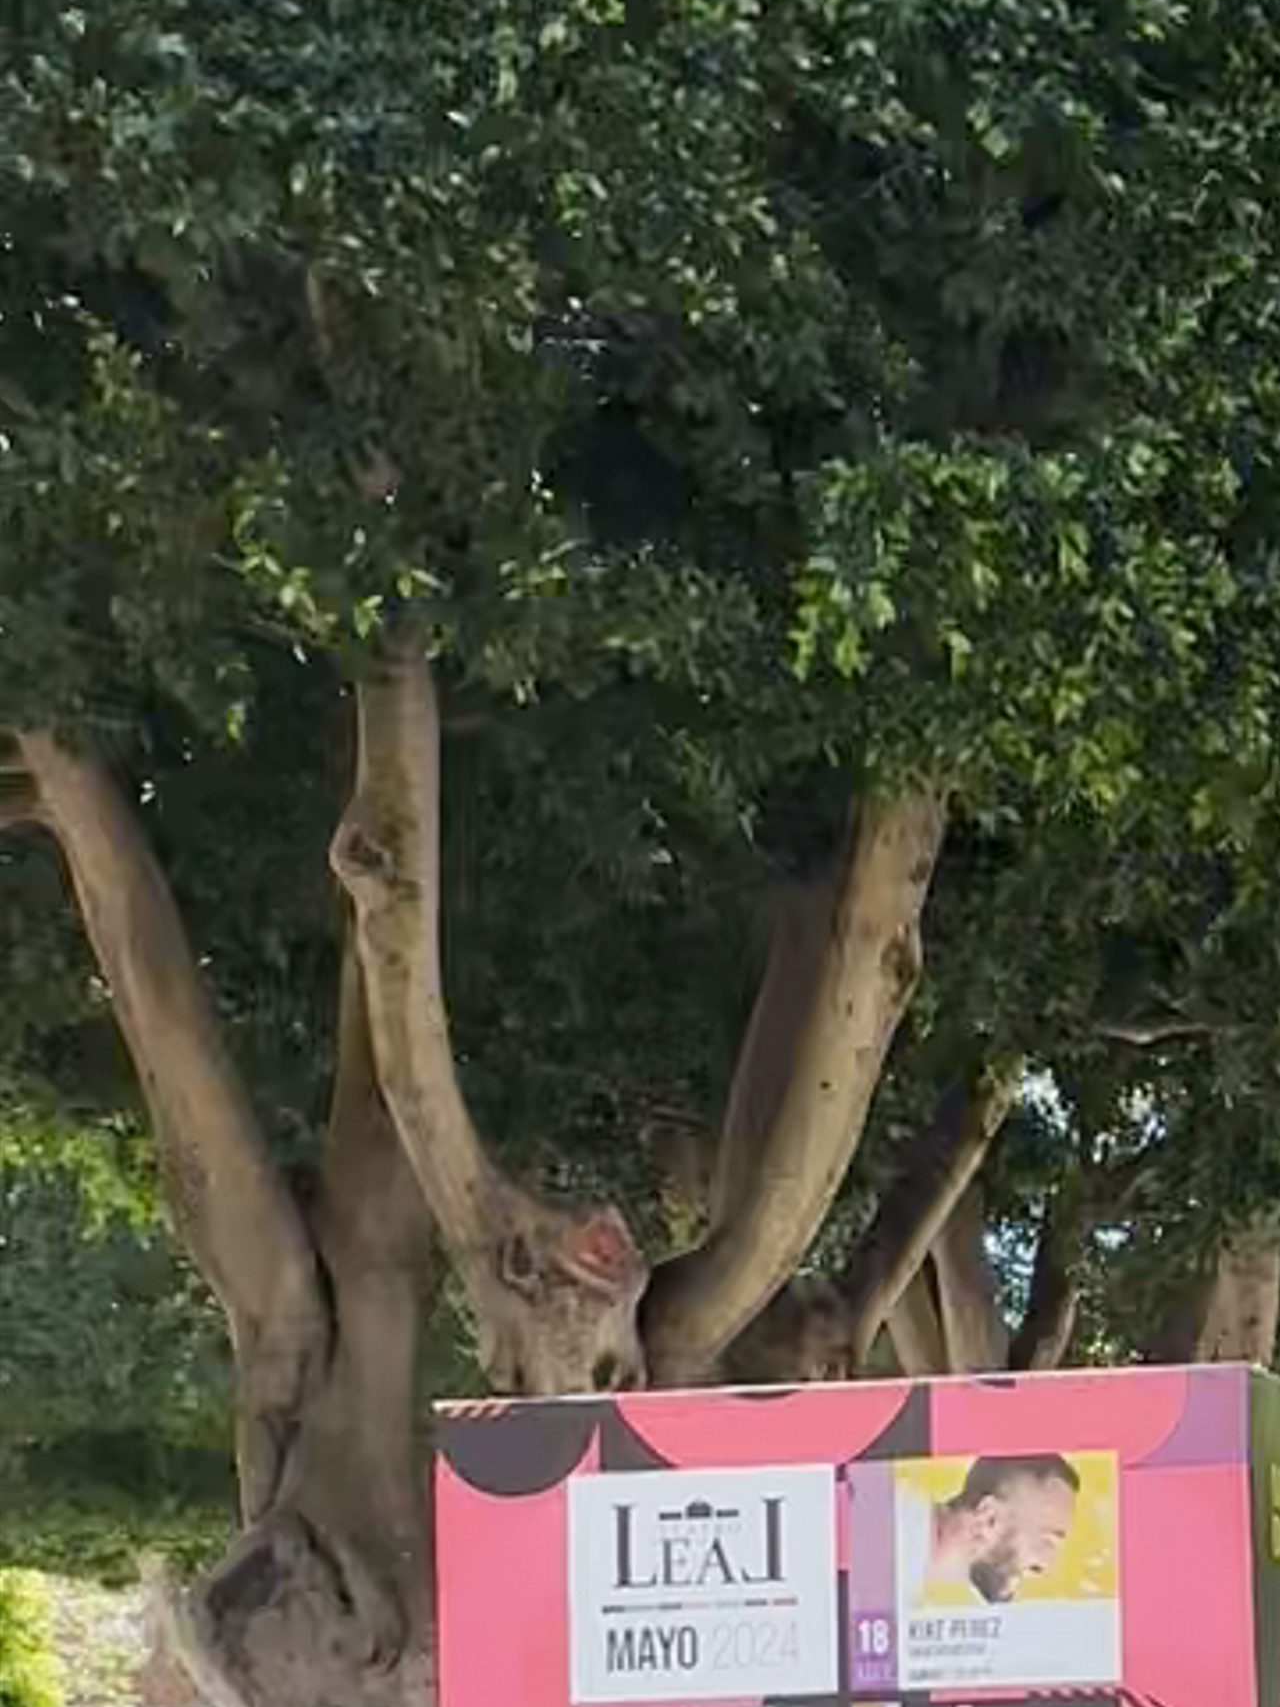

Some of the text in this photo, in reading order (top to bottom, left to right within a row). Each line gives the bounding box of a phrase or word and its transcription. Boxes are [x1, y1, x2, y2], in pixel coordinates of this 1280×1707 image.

[606, 1620, 798, 1672] MAYO 2024
[858, 1619, 890, 1655] 18
